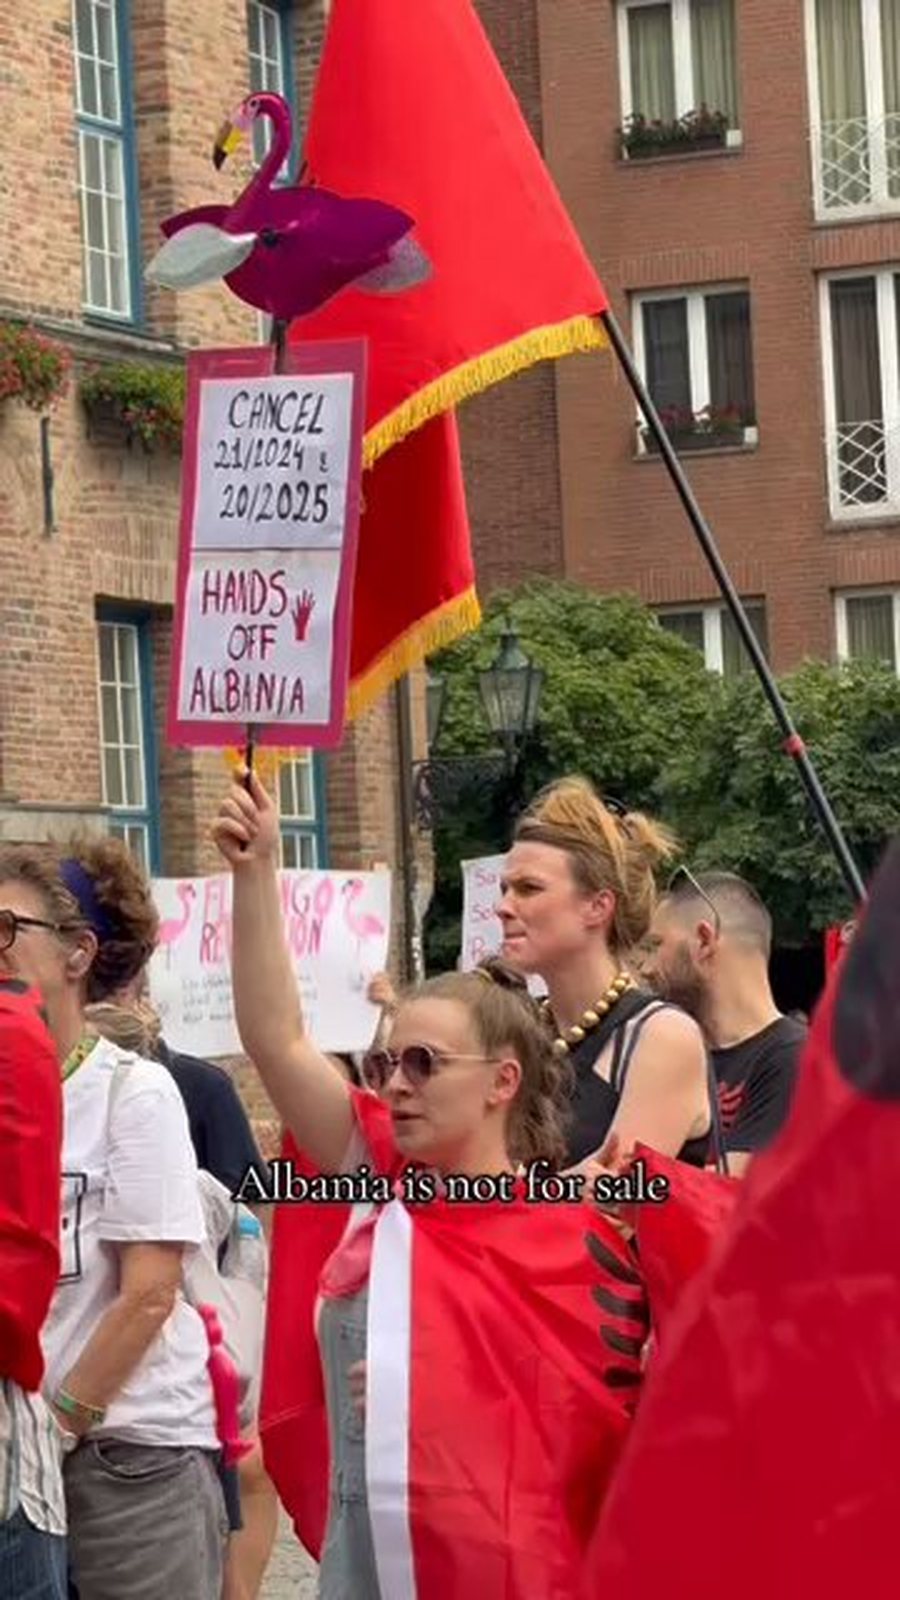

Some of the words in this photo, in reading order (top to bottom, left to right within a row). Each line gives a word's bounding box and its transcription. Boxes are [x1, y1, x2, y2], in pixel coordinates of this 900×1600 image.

[228, 390, 324, 434] CANCEL
[219, 481, 328, 523] 20/2025
[202, 569, 288, 617] HANDS
[227, 624, 277, 661] OFF
[189, 667, 304, 715] ALBANIA
